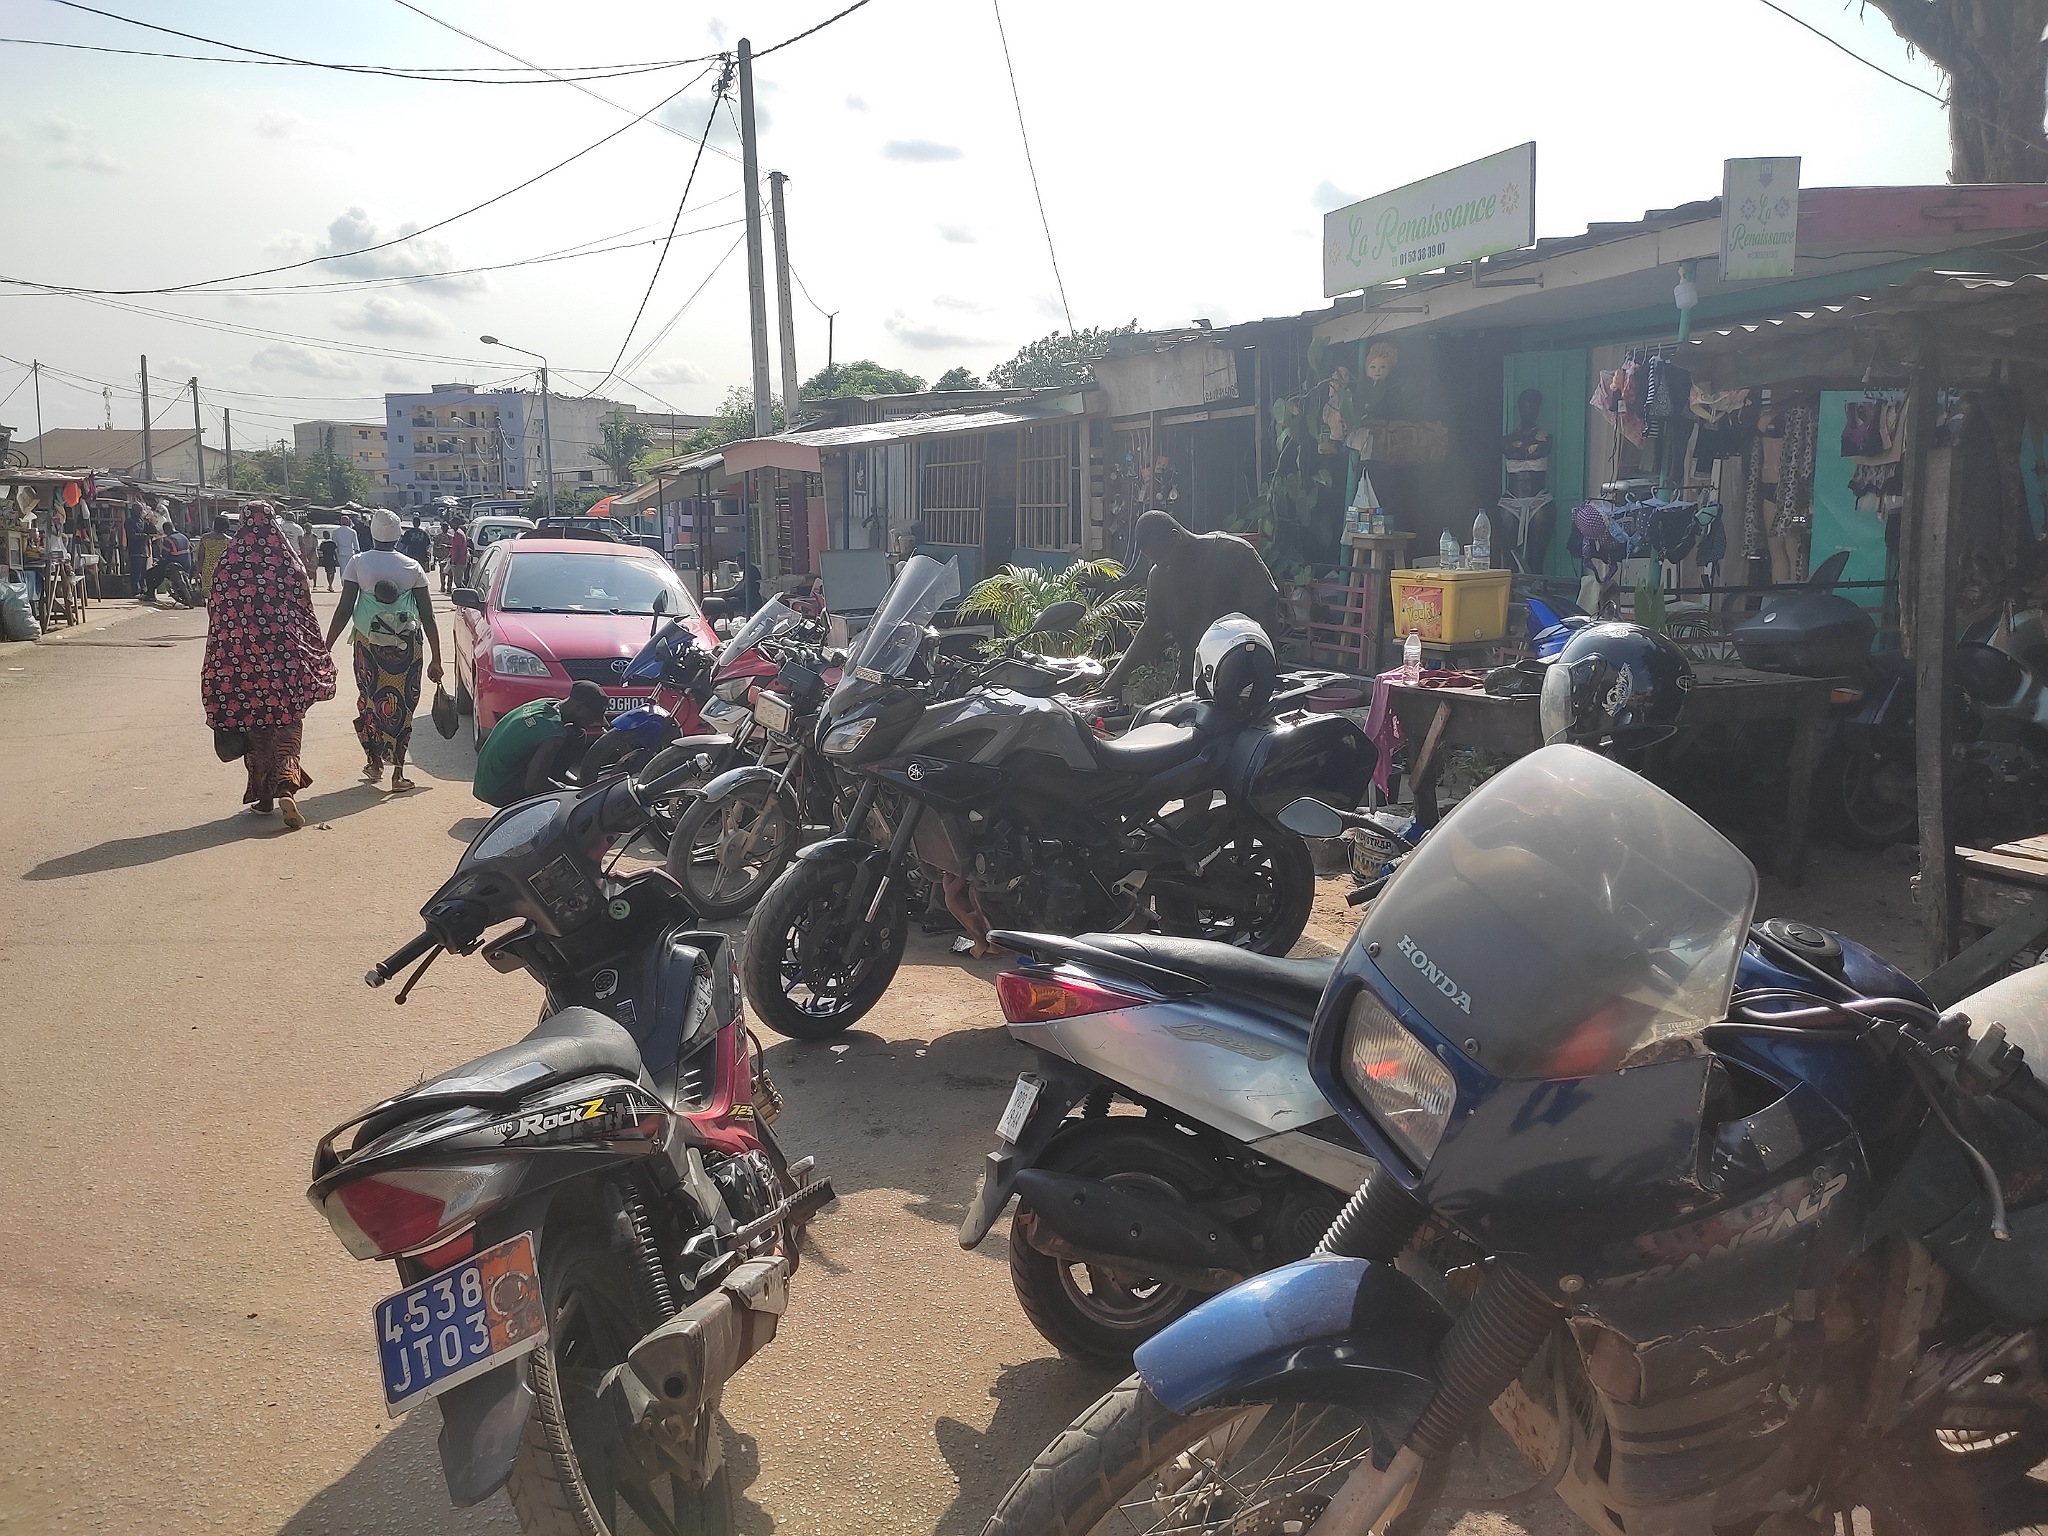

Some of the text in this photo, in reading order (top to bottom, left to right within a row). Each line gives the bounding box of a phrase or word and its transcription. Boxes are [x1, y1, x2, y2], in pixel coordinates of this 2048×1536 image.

[1758, 193, 1772, 225] La
[1346, 193, 1497, 267] La Renaissance
[1729, 223, 1795, 252] Renaissance
[1417, 248, 1426, 261] 38
[1428, 245, 1436, 258] 39
[1437, 242, 1446, 255] 07
[1407, 602, 1435, 622] Youki
[1396, 934, 1472, 1015] HONDA
[728, 1104, 754, 1117] 125
[493, 1121, 513, 1135] TVS
[384, 1266, 483, 1344] 4538
[393, 1310, 490, 1393] JT03
